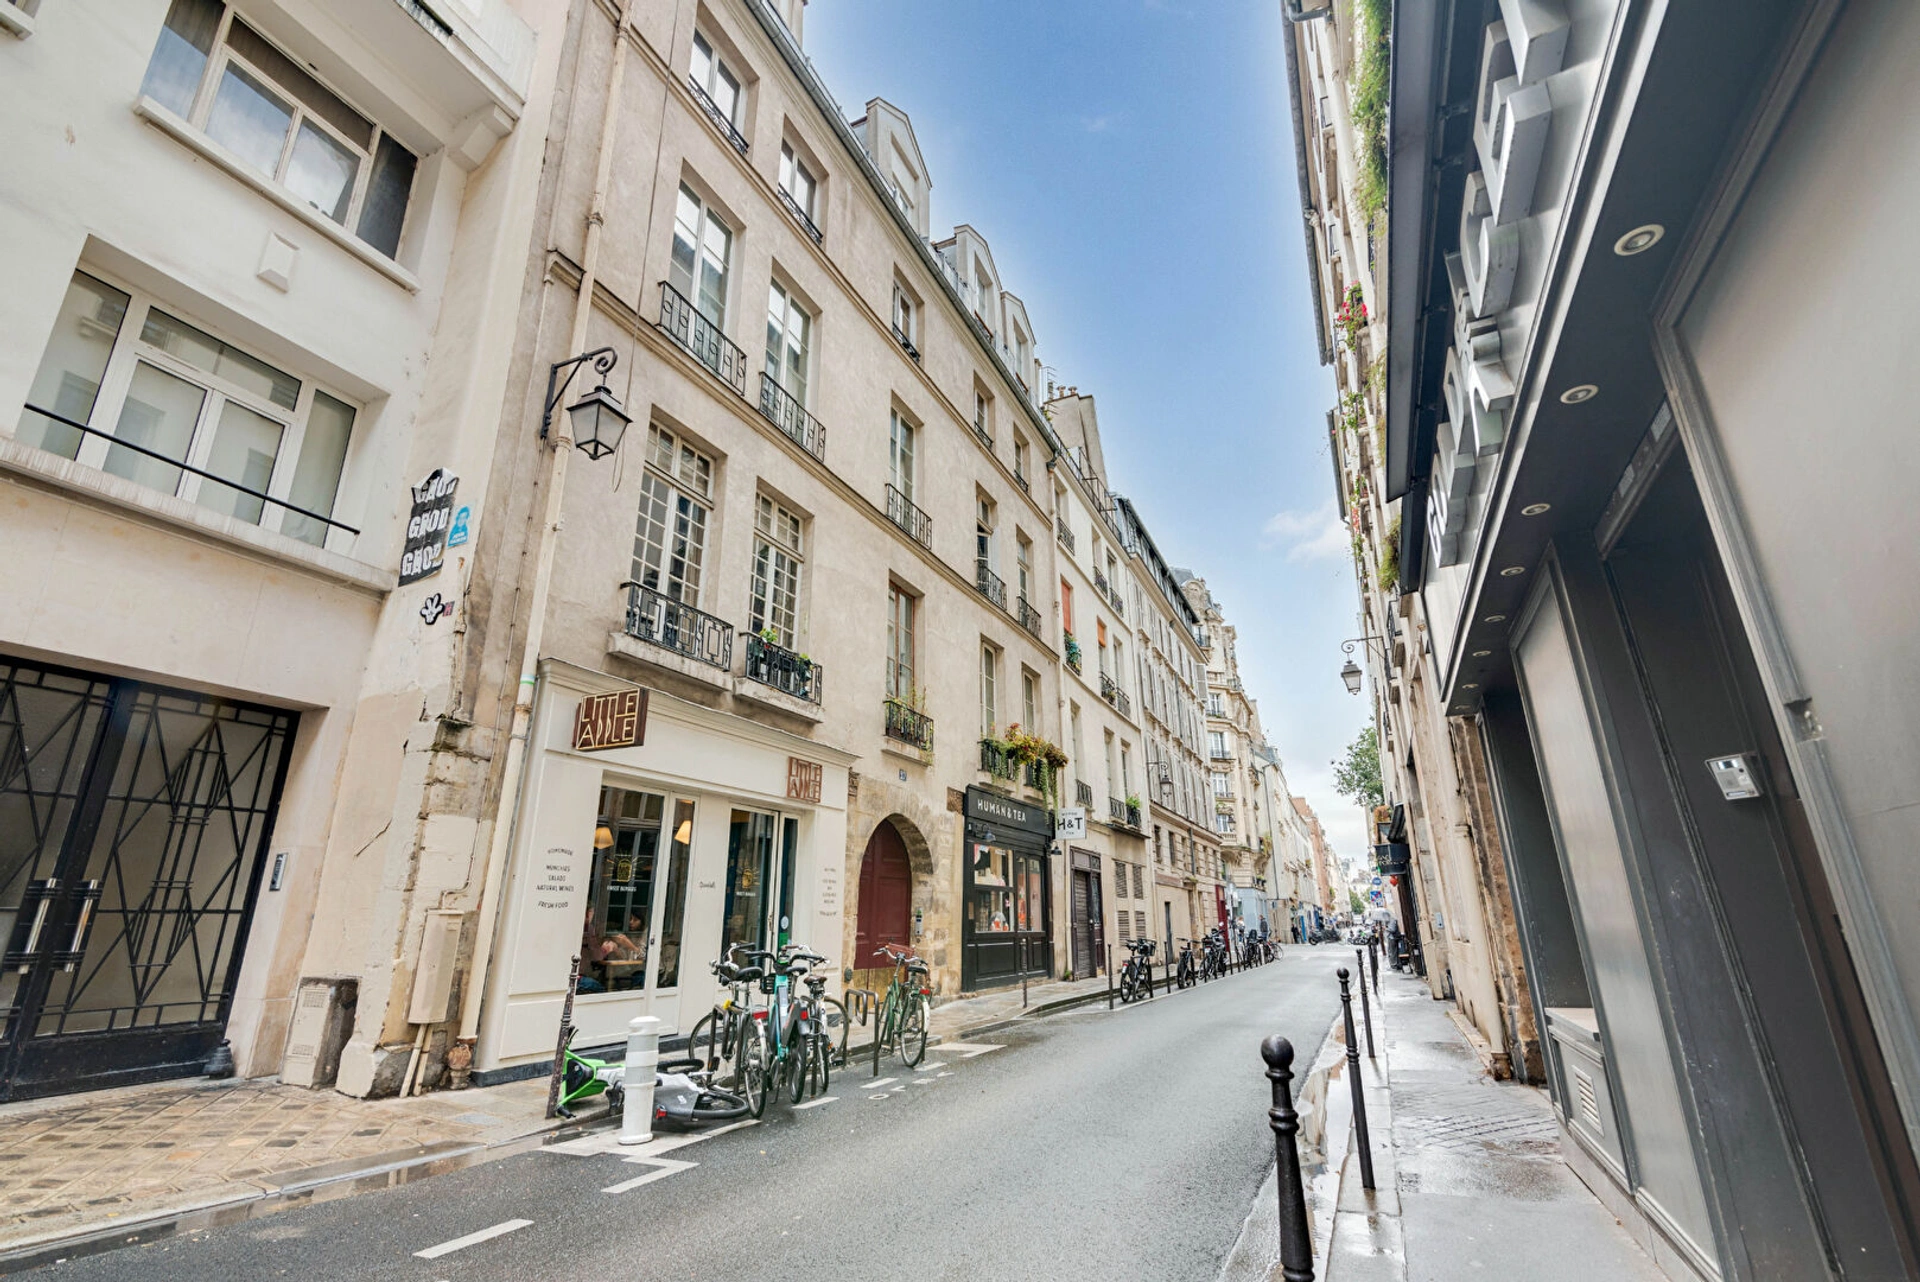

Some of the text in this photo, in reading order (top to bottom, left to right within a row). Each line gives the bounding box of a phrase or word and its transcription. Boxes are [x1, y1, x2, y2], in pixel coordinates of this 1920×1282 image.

[581, 690, 639, 722] LITTLE
[576, 717, 636, 749] APPLE
[1057, 817, 1083, 831] H&T
